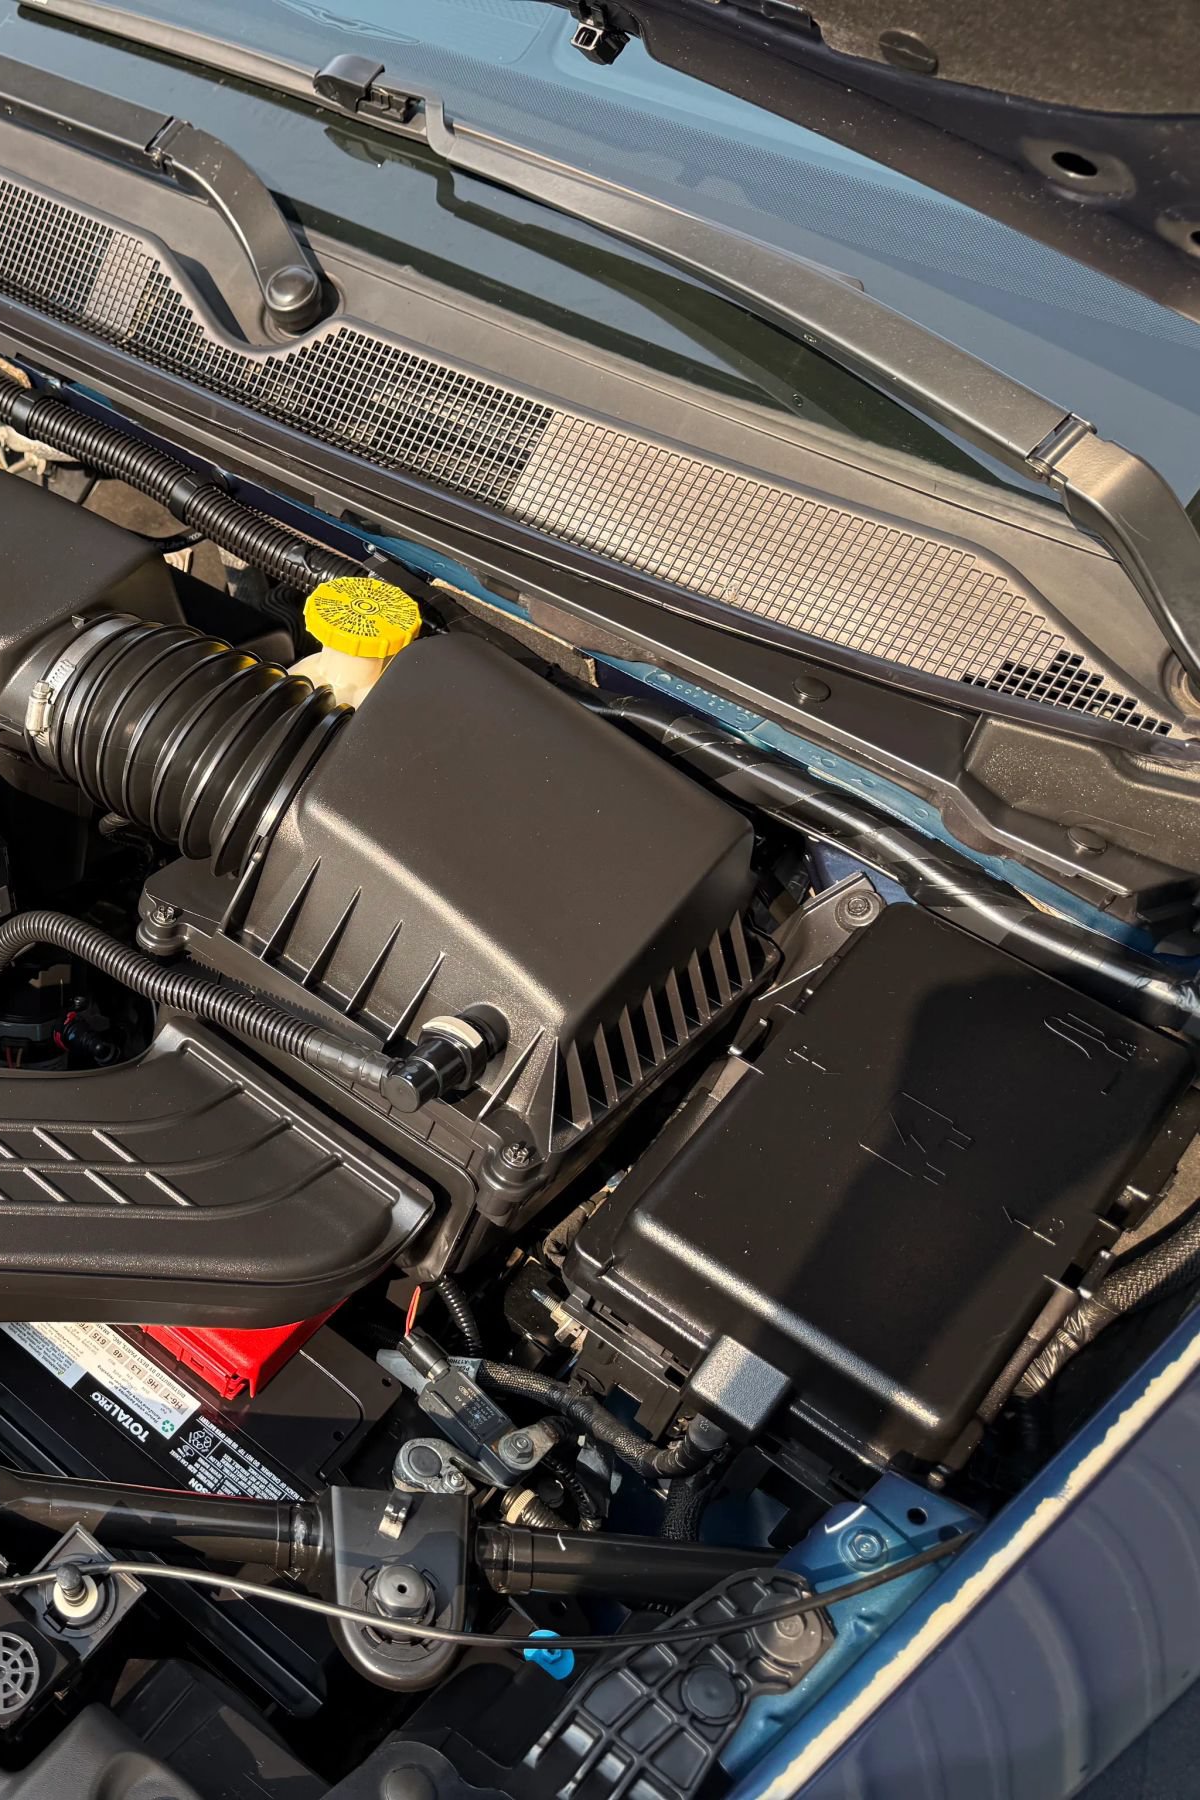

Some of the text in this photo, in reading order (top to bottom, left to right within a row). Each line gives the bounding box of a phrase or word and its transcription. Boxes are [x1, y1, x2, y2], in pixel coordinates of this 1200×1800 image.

[91, 1332, 106, 1345] 615
[112, 1349, 122, 1358] 48
[121, 1342, 137, 1358] PARTS,
[136, 1356, 149, 1368] BEST
[130, 1364, 141, 1375] L3
[148, 1366, 156, 1374] BY
[146, 1377, 158, 1389] H6
[155, 1372, 186, 1398] DISTRIBUTED
[163, 1392, 182, 1409] H6-T
[91, 1392, 148, 1441] TOTALPRO
[208, 1455, 223, 1468] FOLLOW
[244, 1453, 254, 1462] NOT
[252, 1459, 260, 1467] DO
[278, 1481, 286, 1489] OF
[284, 1486, 299, 1499] REACH
